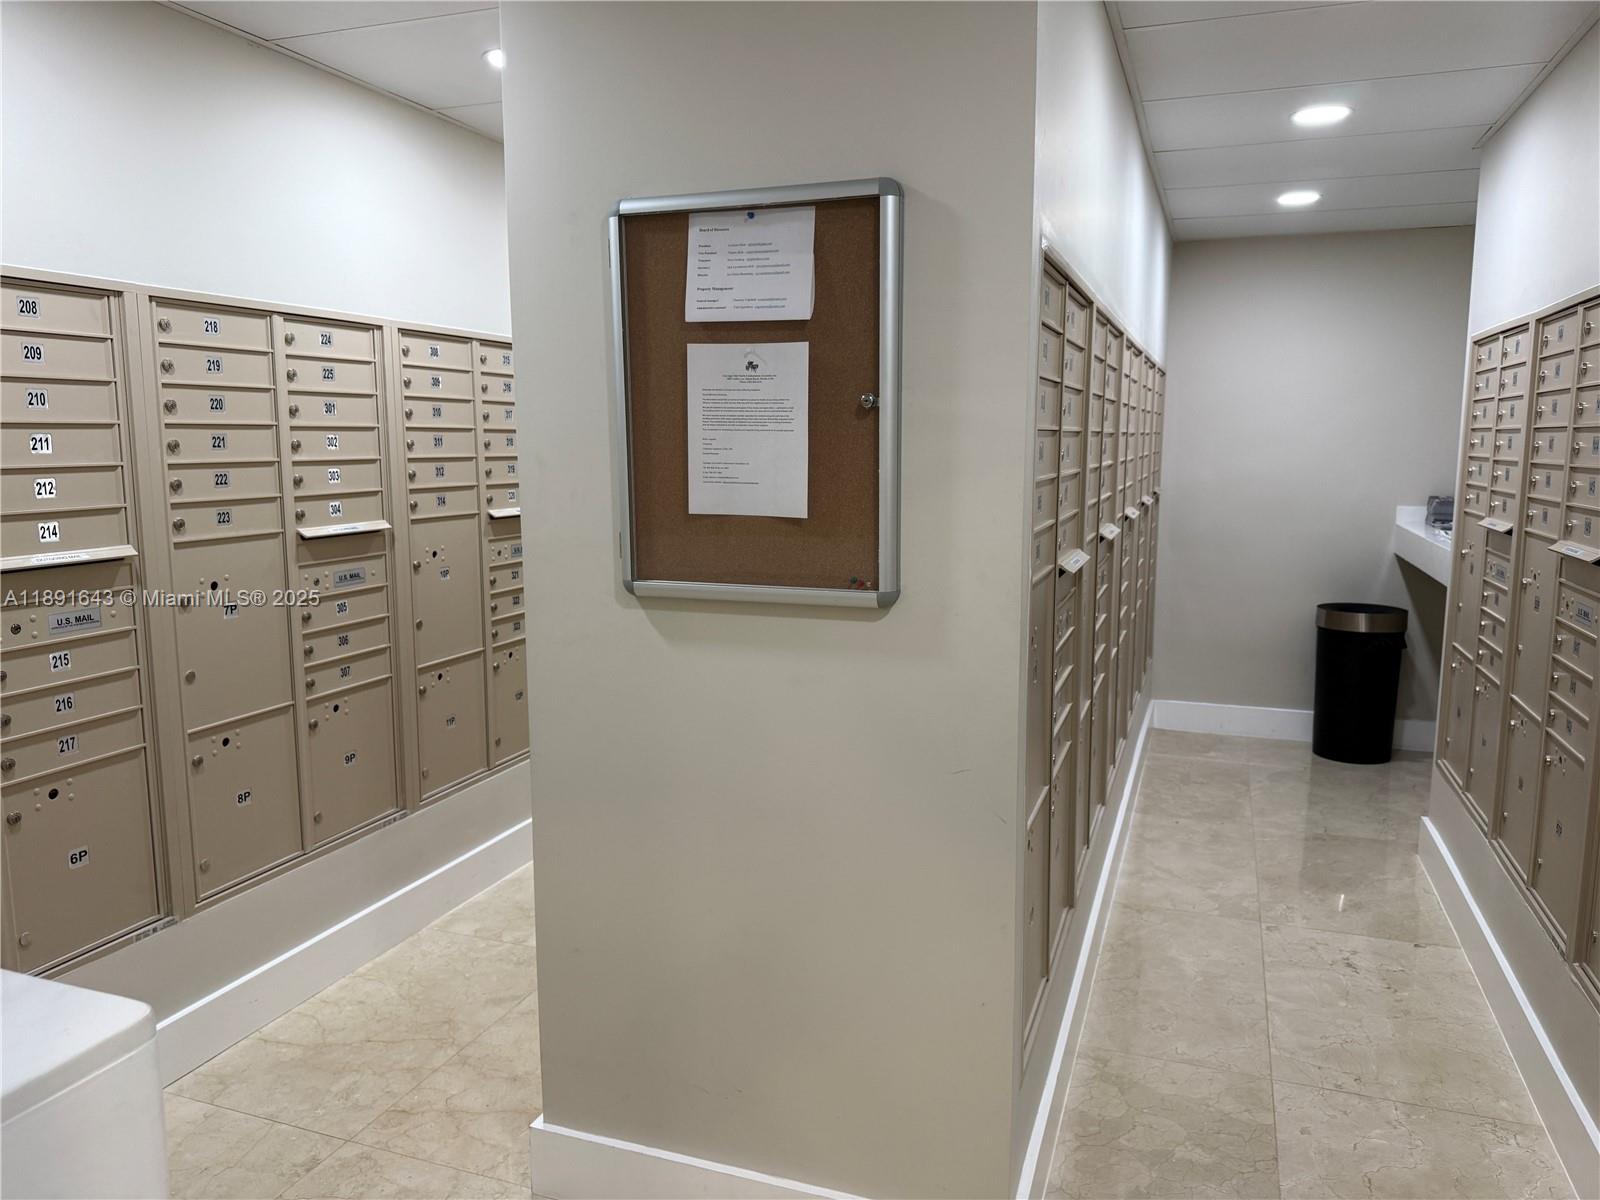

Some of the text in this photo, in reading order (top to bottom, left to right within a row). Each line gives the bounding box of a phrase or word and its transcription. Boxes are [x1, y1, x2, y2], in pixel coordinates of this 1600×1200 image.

[18, 298, 38, 316] 208
[204, 320, 219, 333] 218
[320, 334, 332, 345] 224
[23, 344, 42, 361] 209
[206, 359, 221, 372] 219
[323, 369, 334, 380] 225
[27, 391, 46, 407] 210
[209, 398, 224, 411] 220
[324, 403, 336, 415] 301
[31, 436, 50, 452] 211
[212, 436, 226, 449] 221
[326, 436, 338, 448] 302
[433, 437, 443, 447] 311
[328, 470, 340, 481] 303
[435, 466, 445, 477] 312
[214, 473, 228, 486] 222
[35, 481, 54, 496] 212
[330, 504, 342, 515] 304
[217, 511, 231, 524] 223
[39, 525, 58, 540] 214
[440, 568, 450, 578] 10P
[224, 604, 238, 616] 7P
[336, 601, 348, 614] 305
[56, 617, 73, 626] U.S.
[75, 613, 95, 624] MAIL
[338, 635, 349, 647] 306
[52, 653, 70, 669] 215
[340, 666, 351, 678] 307
[55, 696, 73, 712] 216
[58, 737, 76, 753] 217
[344, 753, 356, 765] 9P
[237, 791, 251, 804] 8P
[69, 850, 88, 865] 6P
